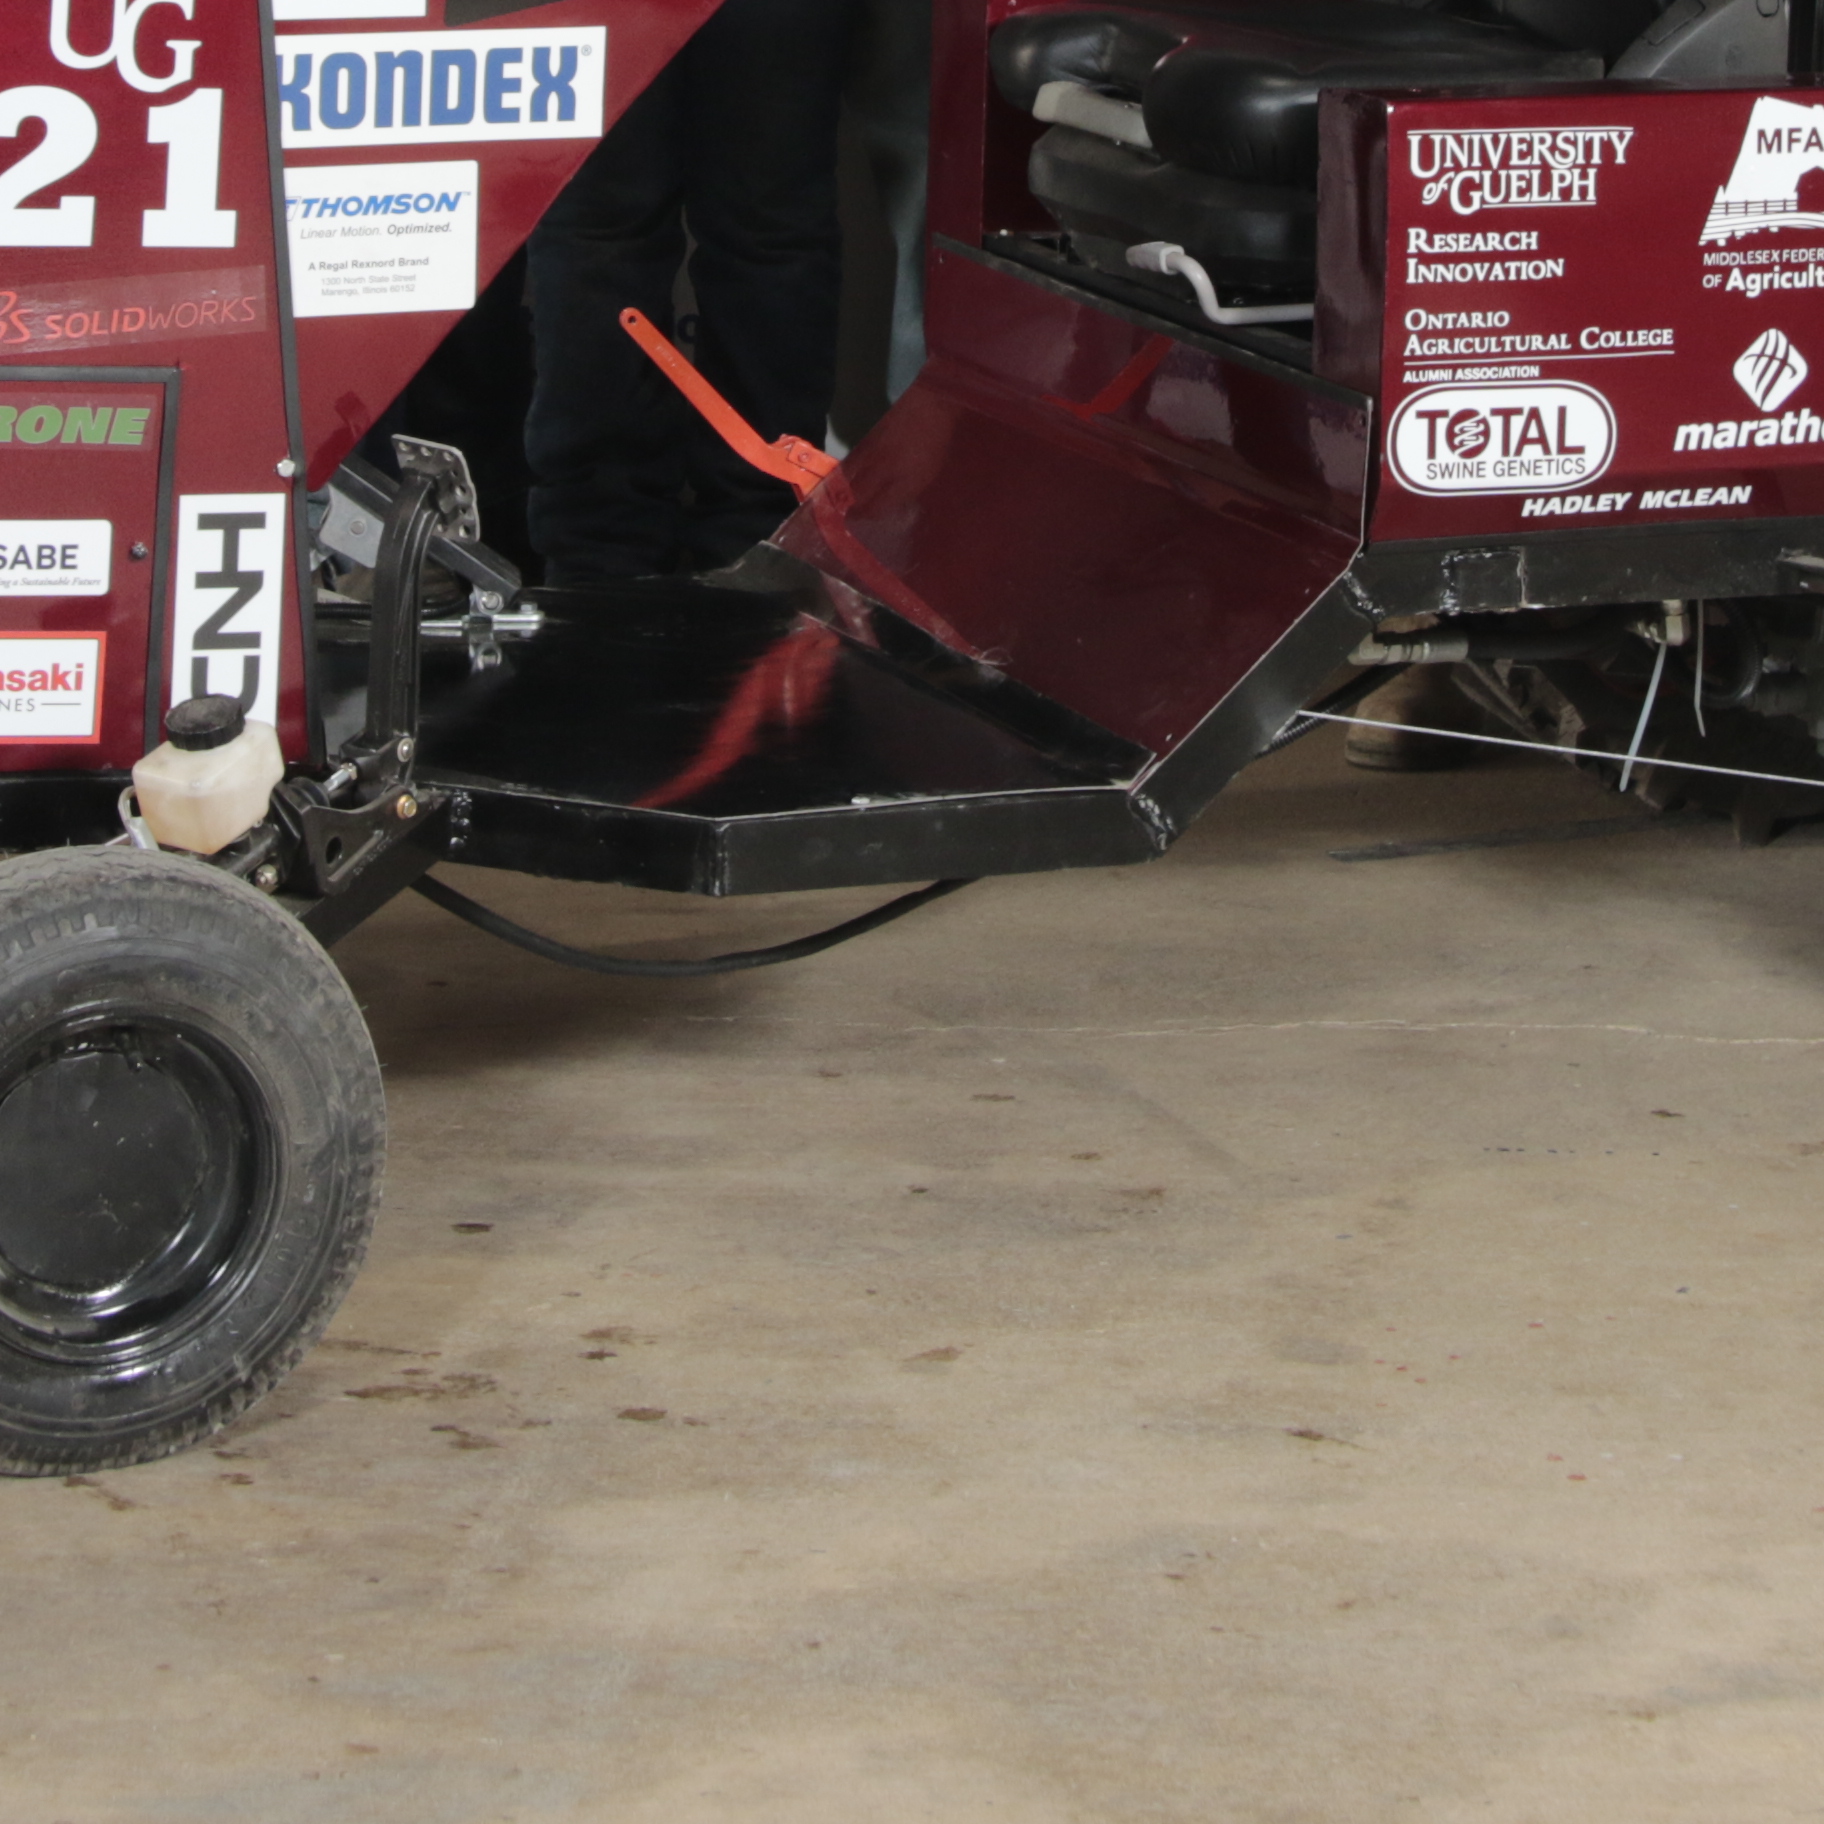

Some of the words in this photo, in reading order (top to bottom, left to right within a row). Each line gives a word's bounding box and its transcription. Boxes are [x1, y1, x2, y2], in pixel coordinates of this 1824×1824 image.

[1757, 127, 1824, 155] MFA
[1407, 130, 1634, 179] UNIVERSITY
[301, 191, 463, 219] THOMSON
[1421, 171, 1455, 205] of
[1449, 168, 1597, 216] GUELPH
[300, 228, 337, 239] Linear
[340, 226, 382, 237] Motion.
[387, 222, 452, 237] Optimized.
[1407, 227, 1539, 254] RESEARCH
[308, 262, 316, 271] A
[318, 260, 348, 272] Regal
[351, 258, 395, 269] Rexnord
[398, 256, 429, 267] Brand
[1703, 248, 1780, 266] MIDDLESEX
[321, 277, 341, 286] 1300
[1406, 258, 1565, 284] INNOVATION
[1702, 274, 1722, 289] OF
[45, 296, 257, 340] SOLIDWORKS
[1404, 308, 1510, 331] ONTARIO
[1403, 333, 1572, 356] AGRICULTURAL
[1579, 326, 1674, 350] COLLEGE
[1403, 368, 1452, 383] ALUMNI
[1454, 364, 1540, 382] ASSOCIATION
[1415, 405, 1586, 460] TOTAL
[1426, 460, 1487, 480] SWINE
[1492, 456, 1586, 478] GENETICS
[1521, 492, 1633, 517] HADLEY
[1639, 485, 1753, 510] MCLEAN
[20, 576, 70, 587] Sustainable
[71, 577, 102, 586] Future
